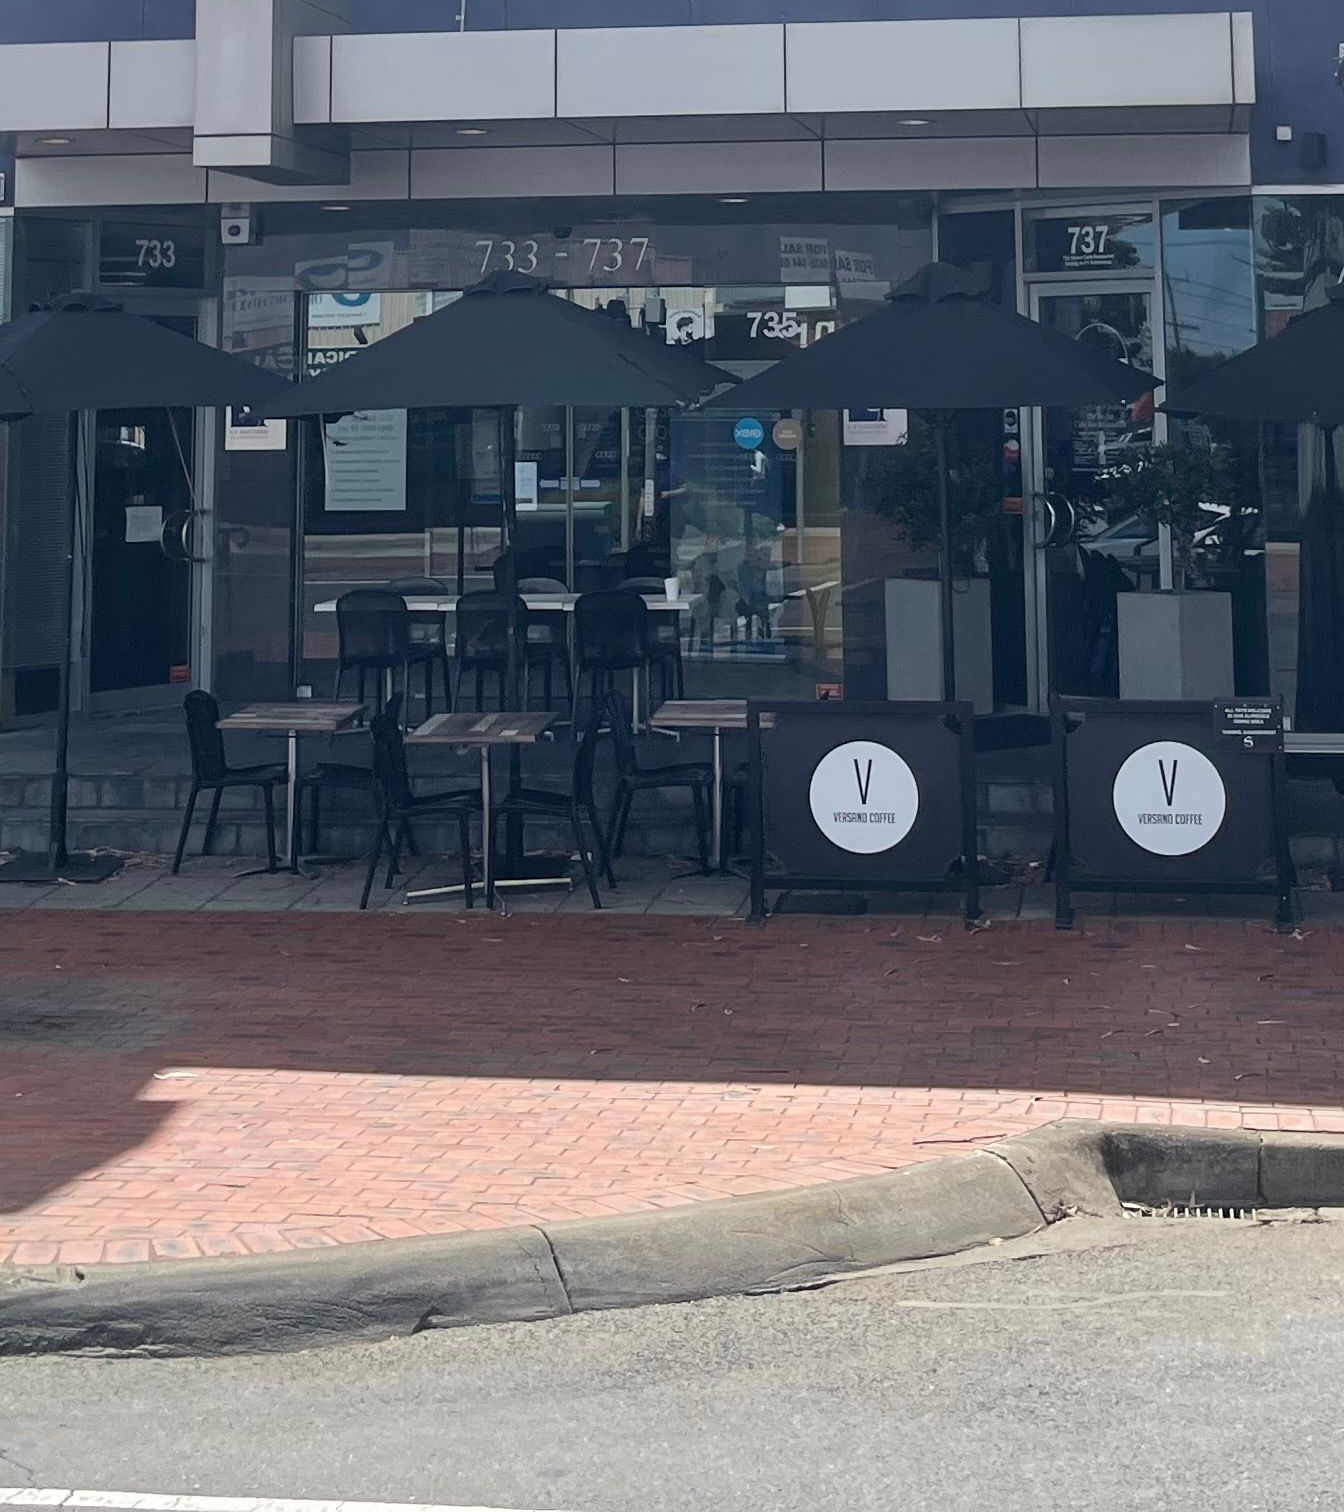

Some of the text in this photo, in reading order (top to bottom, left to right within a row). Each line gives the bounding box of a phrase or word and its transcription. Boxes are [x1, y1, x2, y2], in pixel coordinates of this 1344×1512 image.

[136, 239, 176, 268] 733
[1067, 225, 1109, 255] 737
[476, 239, 538, 274] 733
[583, 237, 649, 272] 737
[747, 311, 802, 338] 735
[833, 812, 896, 824] VERSANO COFFEE
[1138, 813, 1203, 825] VERSANO COFFEE
